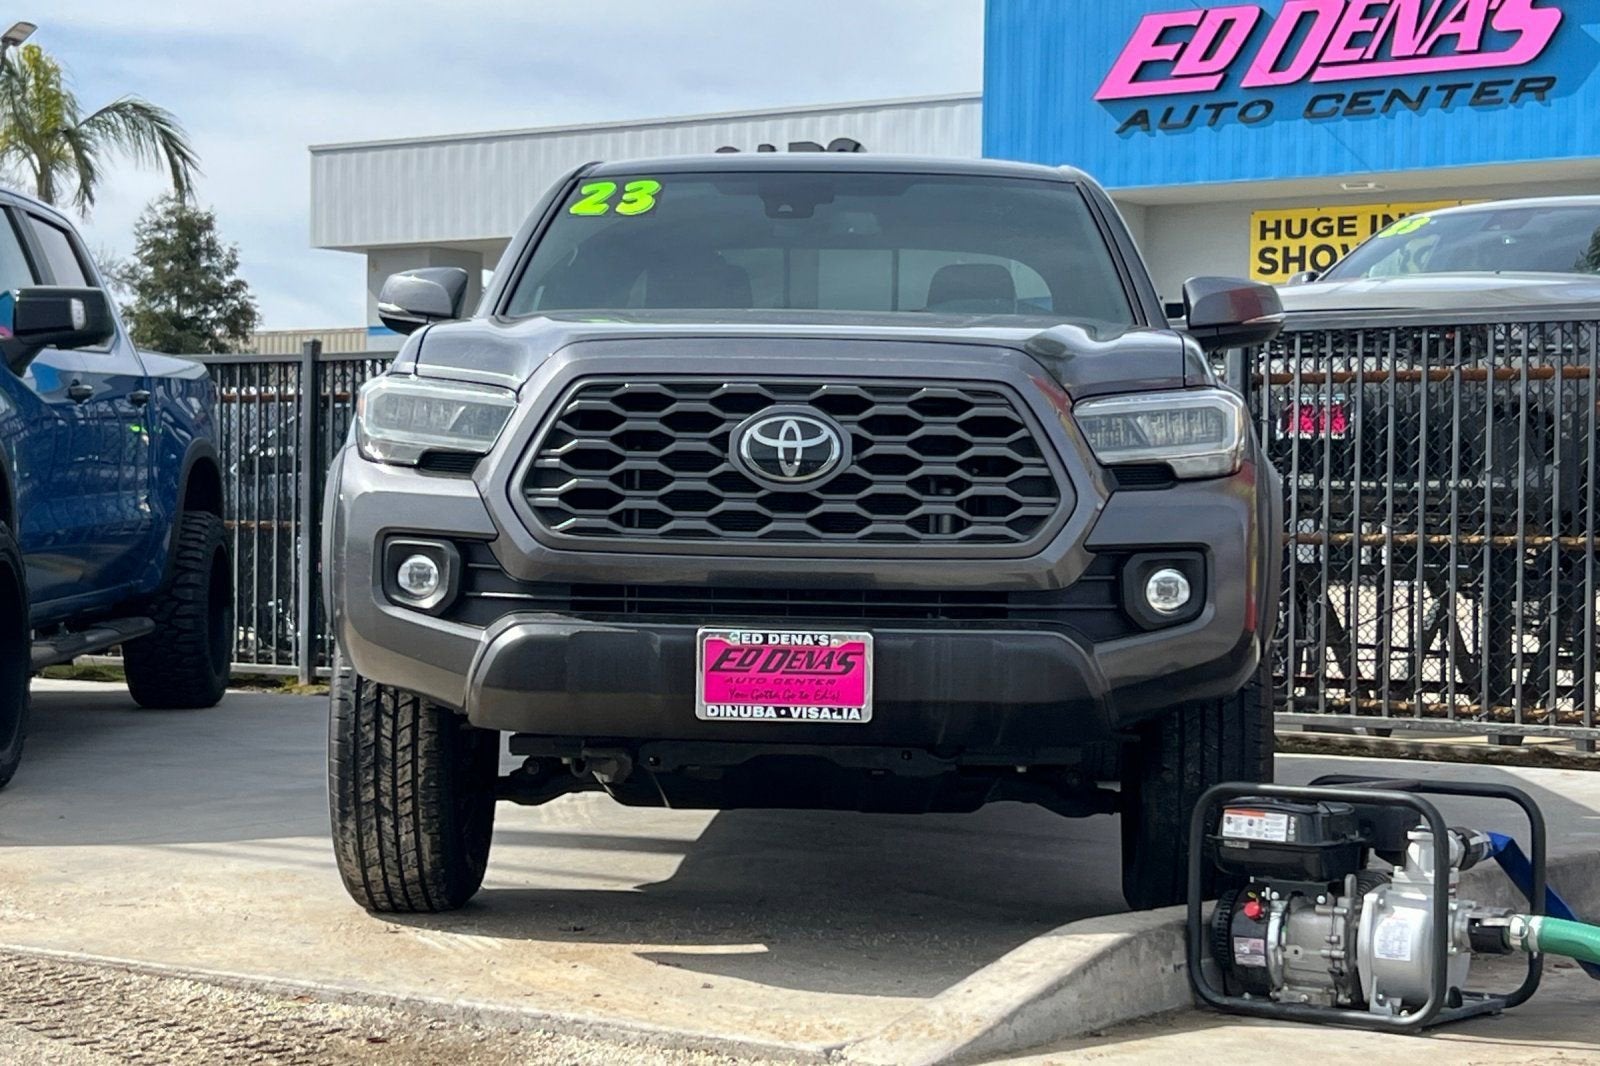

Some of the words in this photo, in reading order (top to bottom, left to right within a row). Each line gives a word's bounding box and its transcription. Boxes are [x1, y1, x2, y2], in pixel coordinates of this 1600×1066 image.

[1094, 4, 1262, 101] ED
[1115, 99, 1274, 135] AUTO
[1302, 76, 1557, 119] CENTER
[569, 180, 662, 216] 23
[1259, 215, 1358, 241] HUGE
[741, 632, 764, 645] ED
[768, 633, 830, 647] DENA'S
[709, 648, 764, 673] ED
[757, 649, 864, 676] DENA'S
[725, 676, 767, 685] AUTO
[773, 677, 837, 686] CENTER
[706, 704, 778, 718] DINUBA
[789, 706, 861, 720] VISALIA
